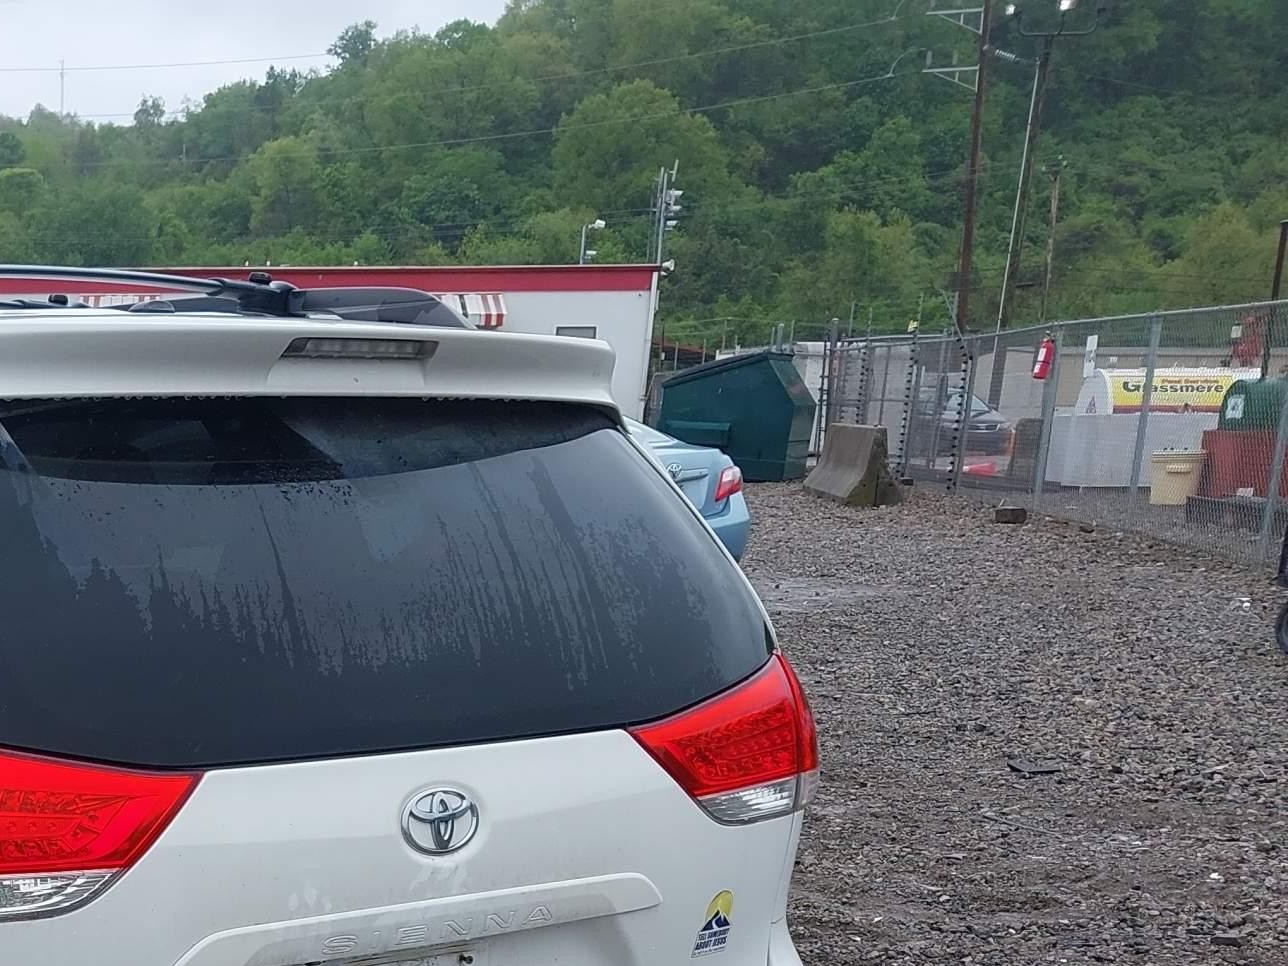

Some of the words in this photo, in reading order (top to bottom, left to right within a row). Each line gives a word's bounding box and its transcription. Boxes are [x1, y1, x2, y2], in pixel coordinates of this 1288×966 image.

[1122, 381, 1224, 393] Gassmere
[320, 904, 553, 956] SIENNA
[695, 939, 712, 951] ABOUT
[712, 936, 727, 947] JESUS
